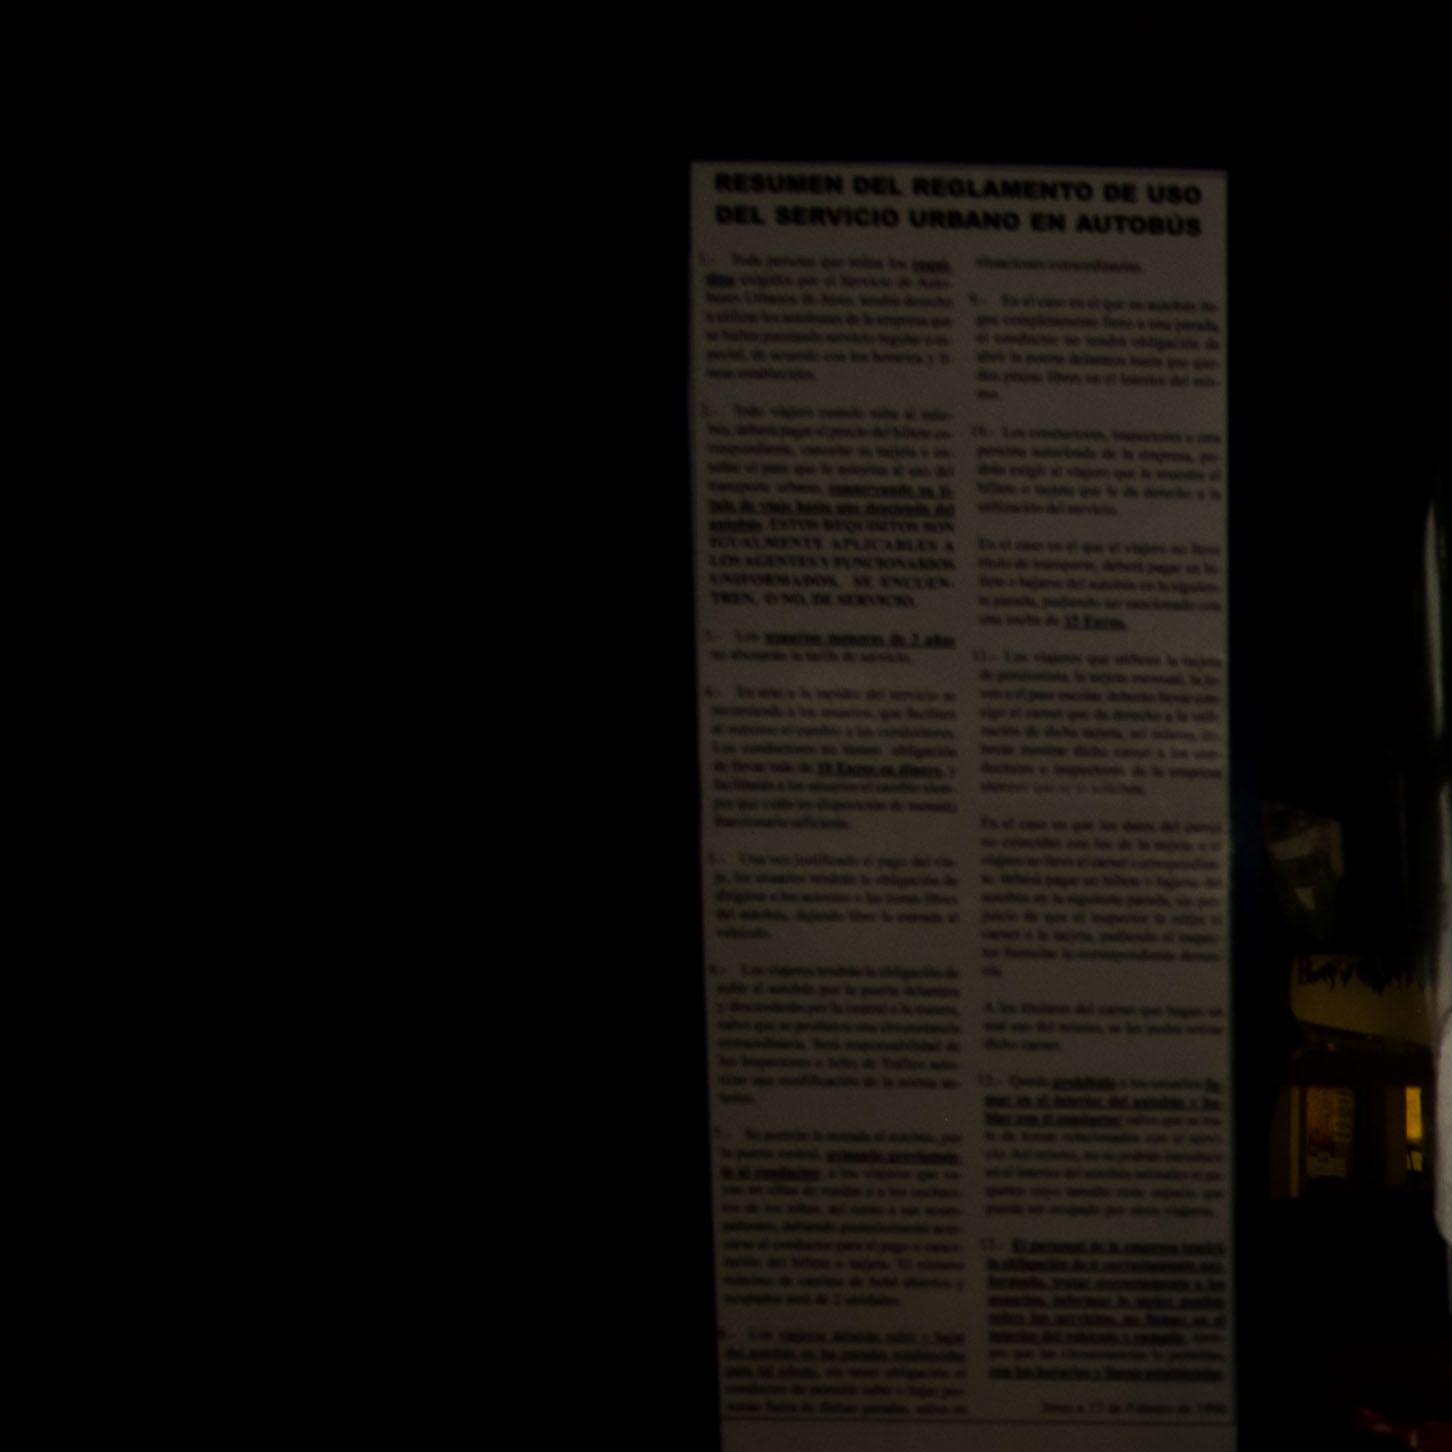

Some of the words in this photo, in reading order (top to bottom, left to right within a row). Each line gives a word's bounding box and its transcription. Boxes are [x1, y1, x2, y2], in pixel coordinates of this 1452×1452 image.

[715, 173, 843, 195] RESUMEN
[853, 177, 903, 196] DEL
[912, 179, 1094, 202] REGLAMENTO
[1103, 183, 1137, 203] DE
[1148, 184, 1202, 205] USO
[716, 205, 765, 226] DEL
[775, 206, 899, 229] SERVICIO
[909, 210, 1021, 232] URBANO
[1030, 213, 1067, 232] EN
[1075, 213, 1202, 236] AUTOBÚS
